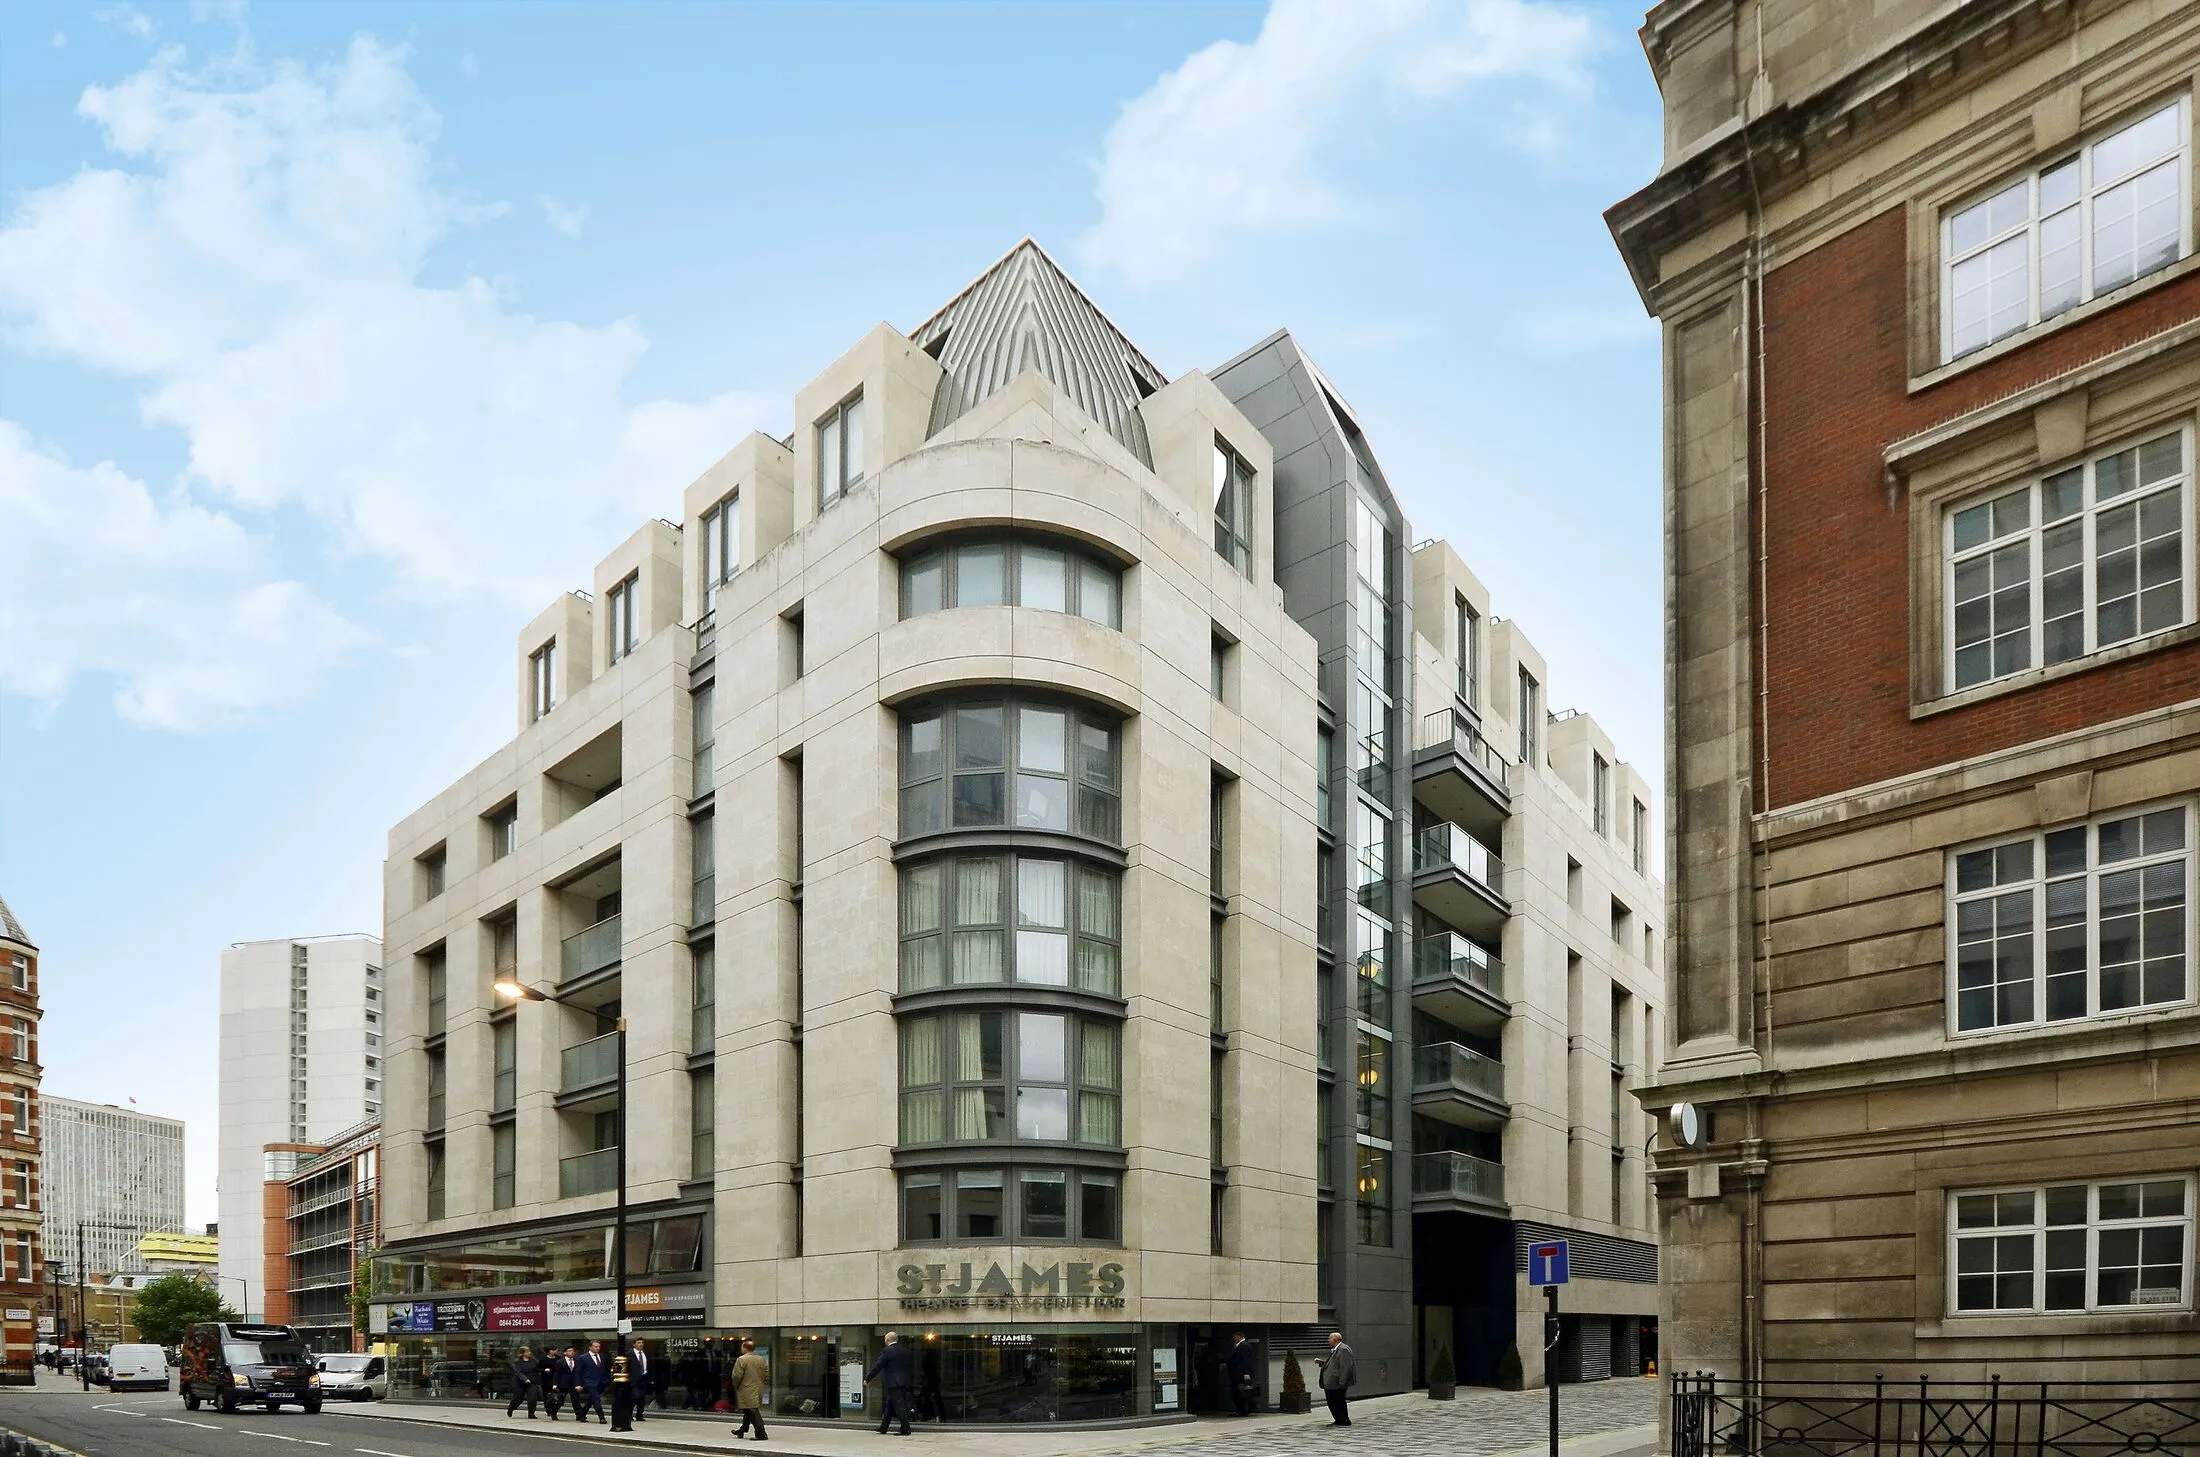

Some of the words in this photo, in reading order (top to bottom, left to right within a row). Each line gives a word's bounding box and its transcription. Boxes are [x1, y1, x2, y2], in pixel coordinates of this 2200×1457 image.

[493, 1304, 540, 1314] stjamestheatre.co.uk
[899, 1298, 969, 1310] THEATRE
[984, 1298, 1084, 1310] BRASSERIE
[1094, 1297, 1125, 1309] BAR
